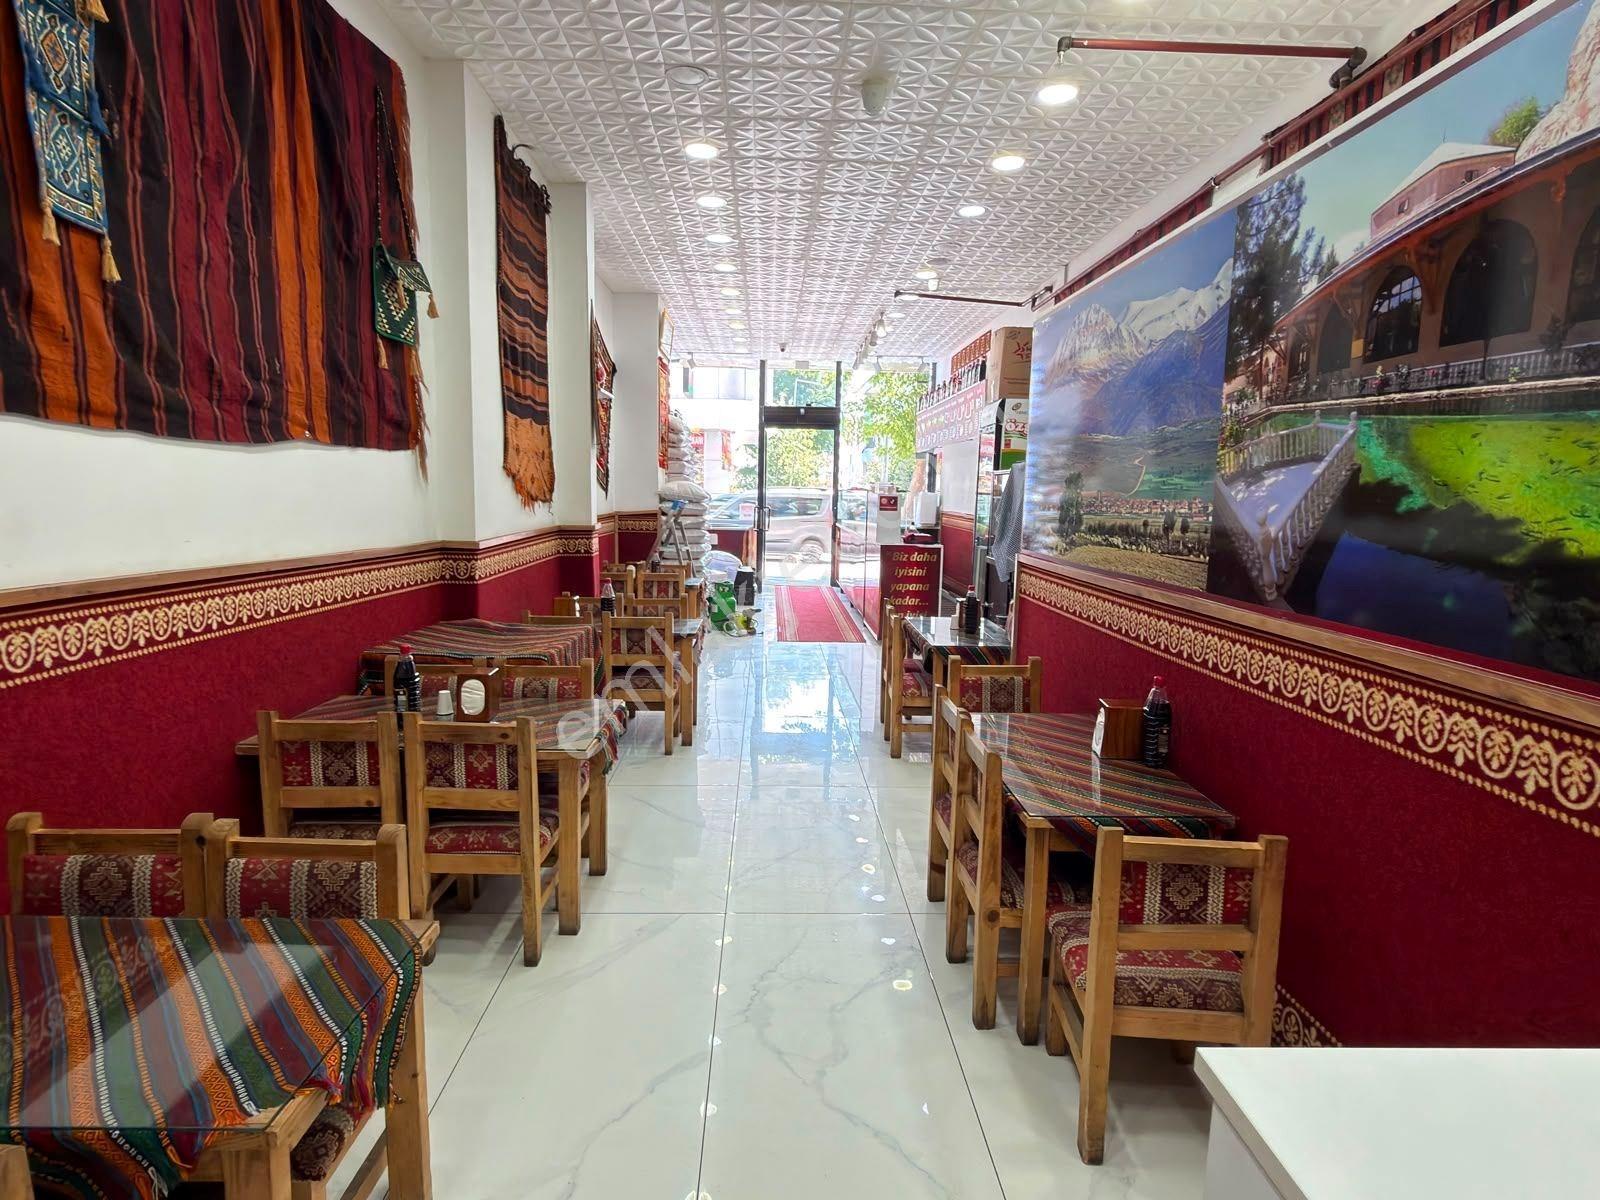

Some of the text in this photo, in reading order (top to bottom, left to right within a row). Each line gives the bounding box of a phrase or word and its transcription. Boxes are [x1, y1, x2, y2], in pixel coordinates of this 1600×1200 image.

[892, 551, 938, 562] Biz daha
[894, 566, 927, 578] iyisini
[889, 583, 930, 593] yapana
